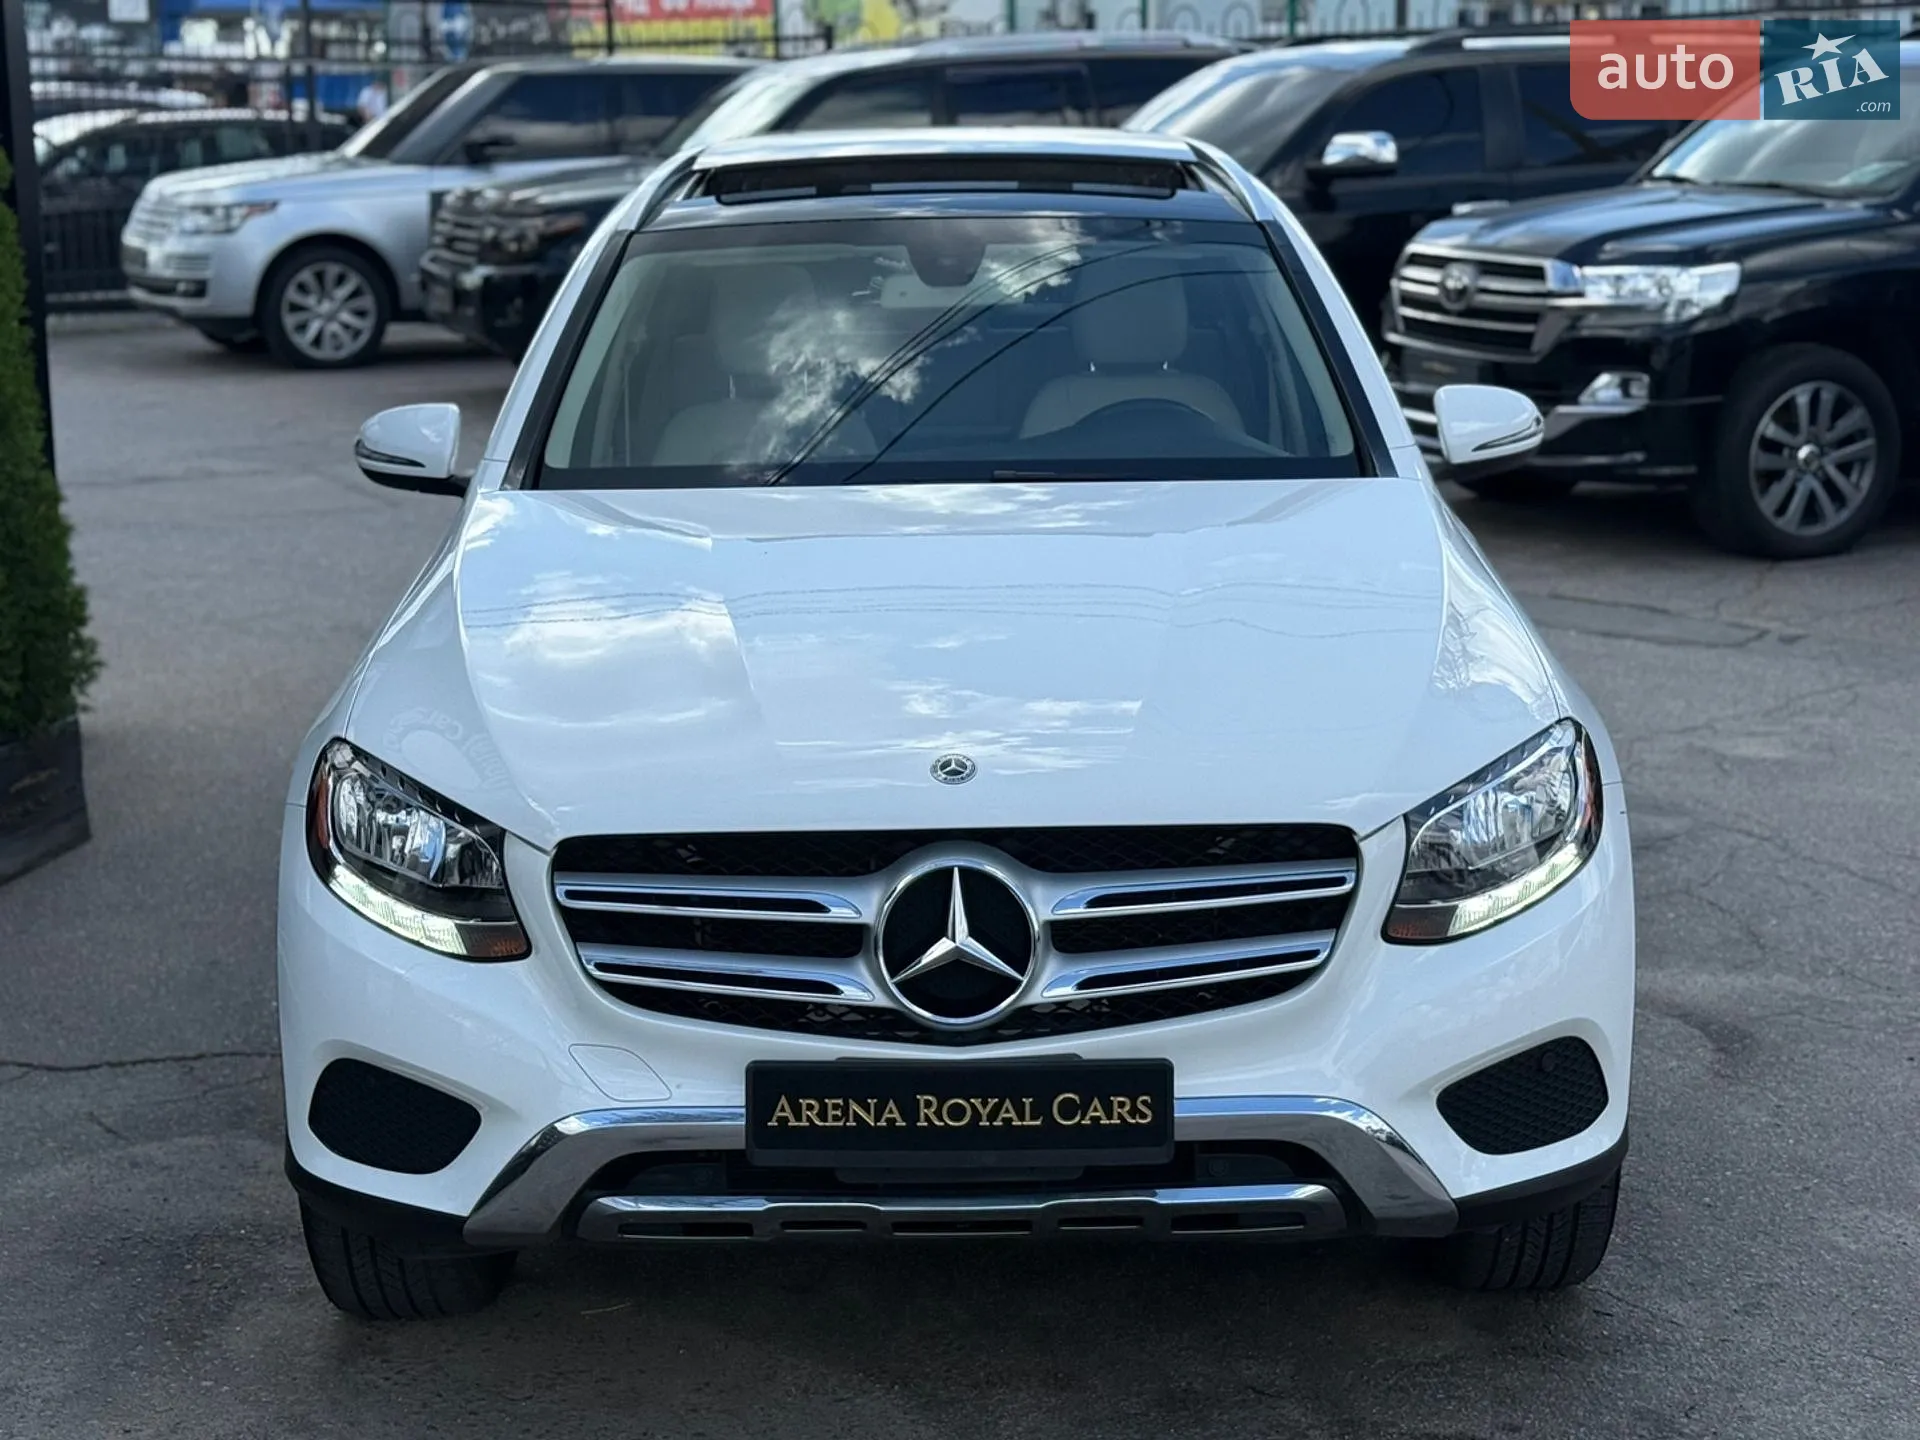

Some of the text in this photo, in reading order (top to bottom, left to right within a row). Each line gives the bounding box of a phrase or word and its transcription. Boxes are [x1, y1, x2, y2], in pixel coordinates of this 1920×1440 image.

[766, 1093, 1153, 1127] ARENA ROYAL CARS
